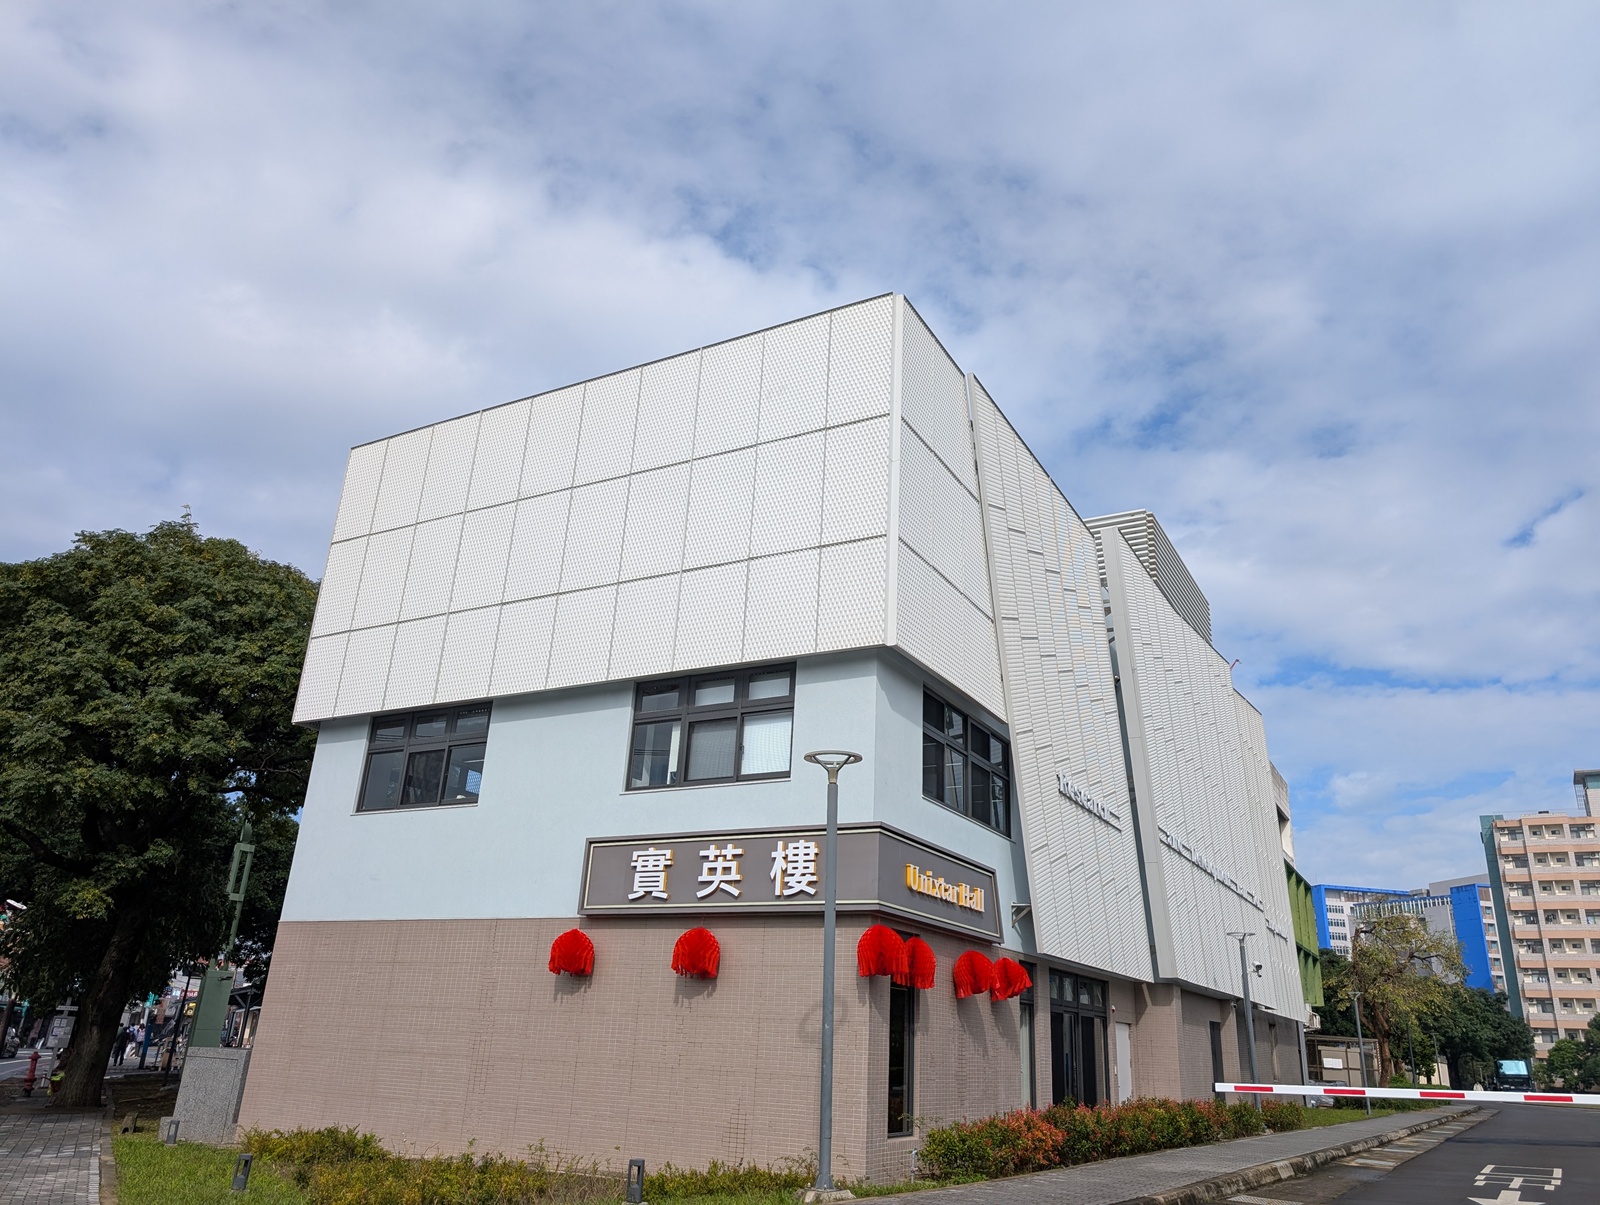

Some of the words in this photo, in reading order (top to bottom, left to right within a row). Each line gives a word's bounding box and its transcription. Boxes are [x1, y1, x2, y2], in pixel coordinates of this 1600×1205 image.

[627, 839, 820, 900] 實英樓
[905, 863, 959, 904] Unixtar
[958, 882, 985, 912] Hall
